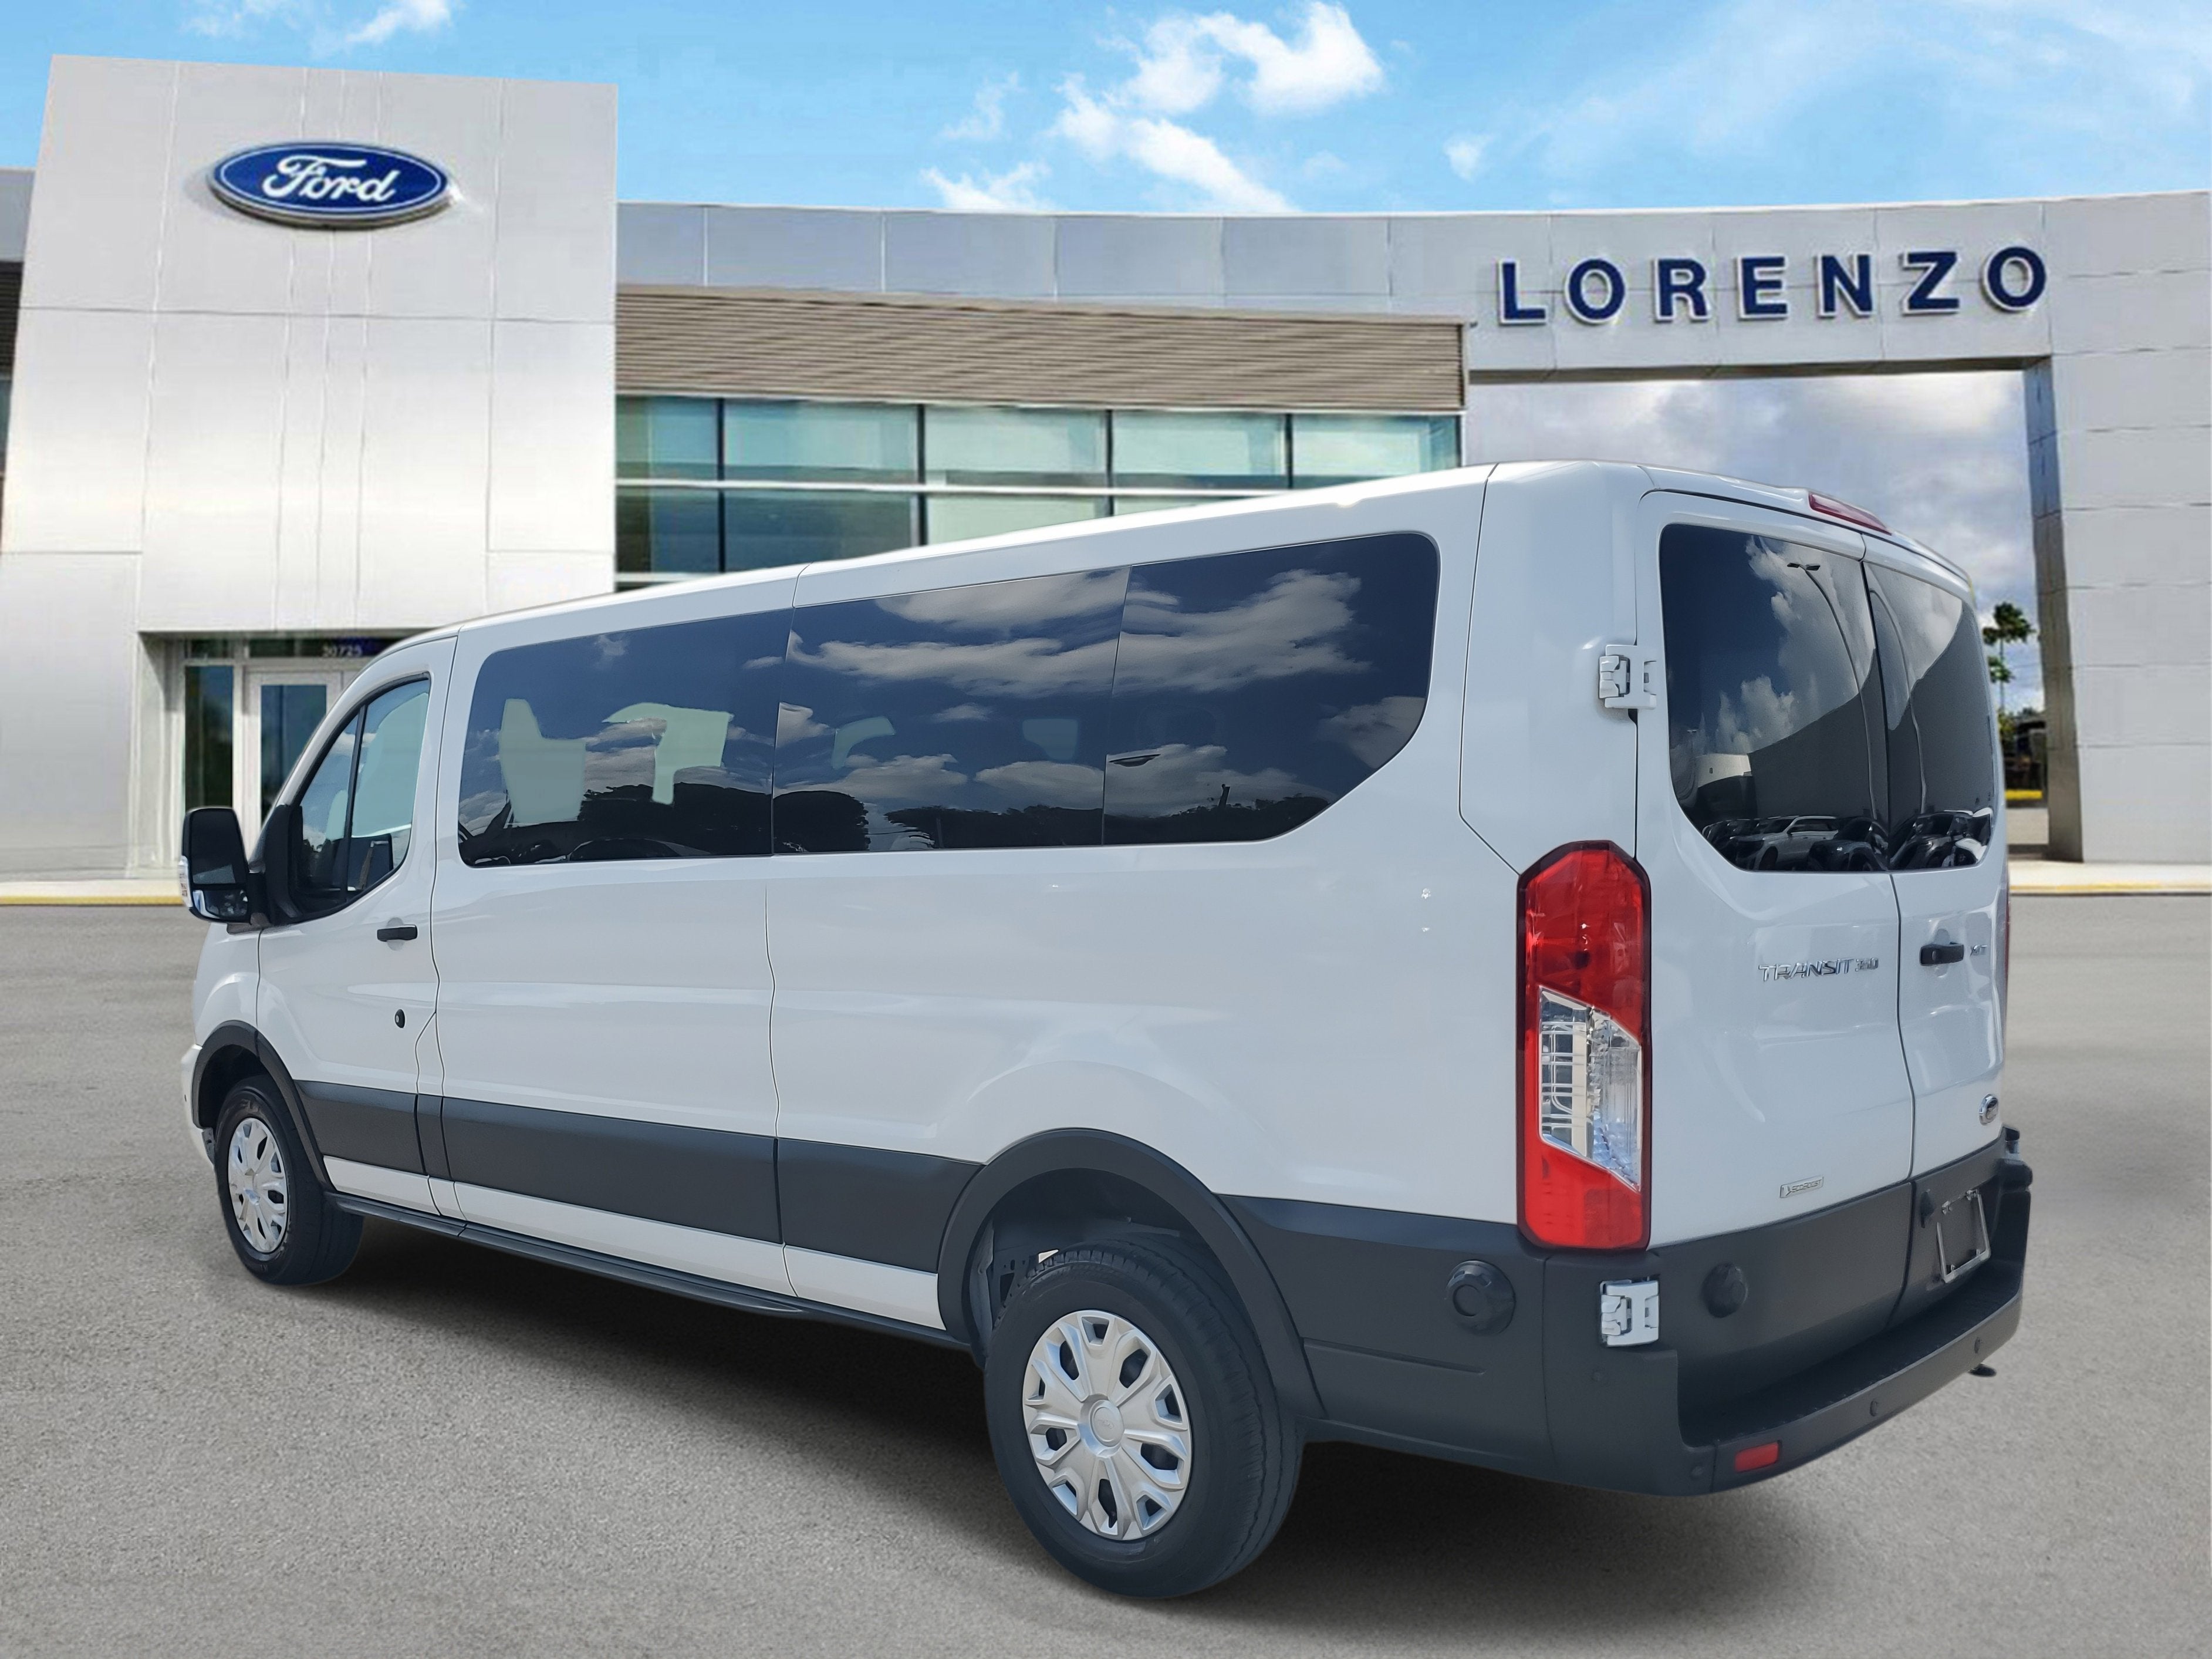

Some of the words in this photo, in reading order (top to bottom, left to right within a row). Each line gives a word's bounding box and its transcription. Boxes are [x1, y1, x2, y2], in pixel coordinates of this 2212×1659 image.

[262, 155, 400, 202] Ford
[1498, 245, 2047, 325] LORENZO
[1758, 958, 1854, 982] TRANSIT
